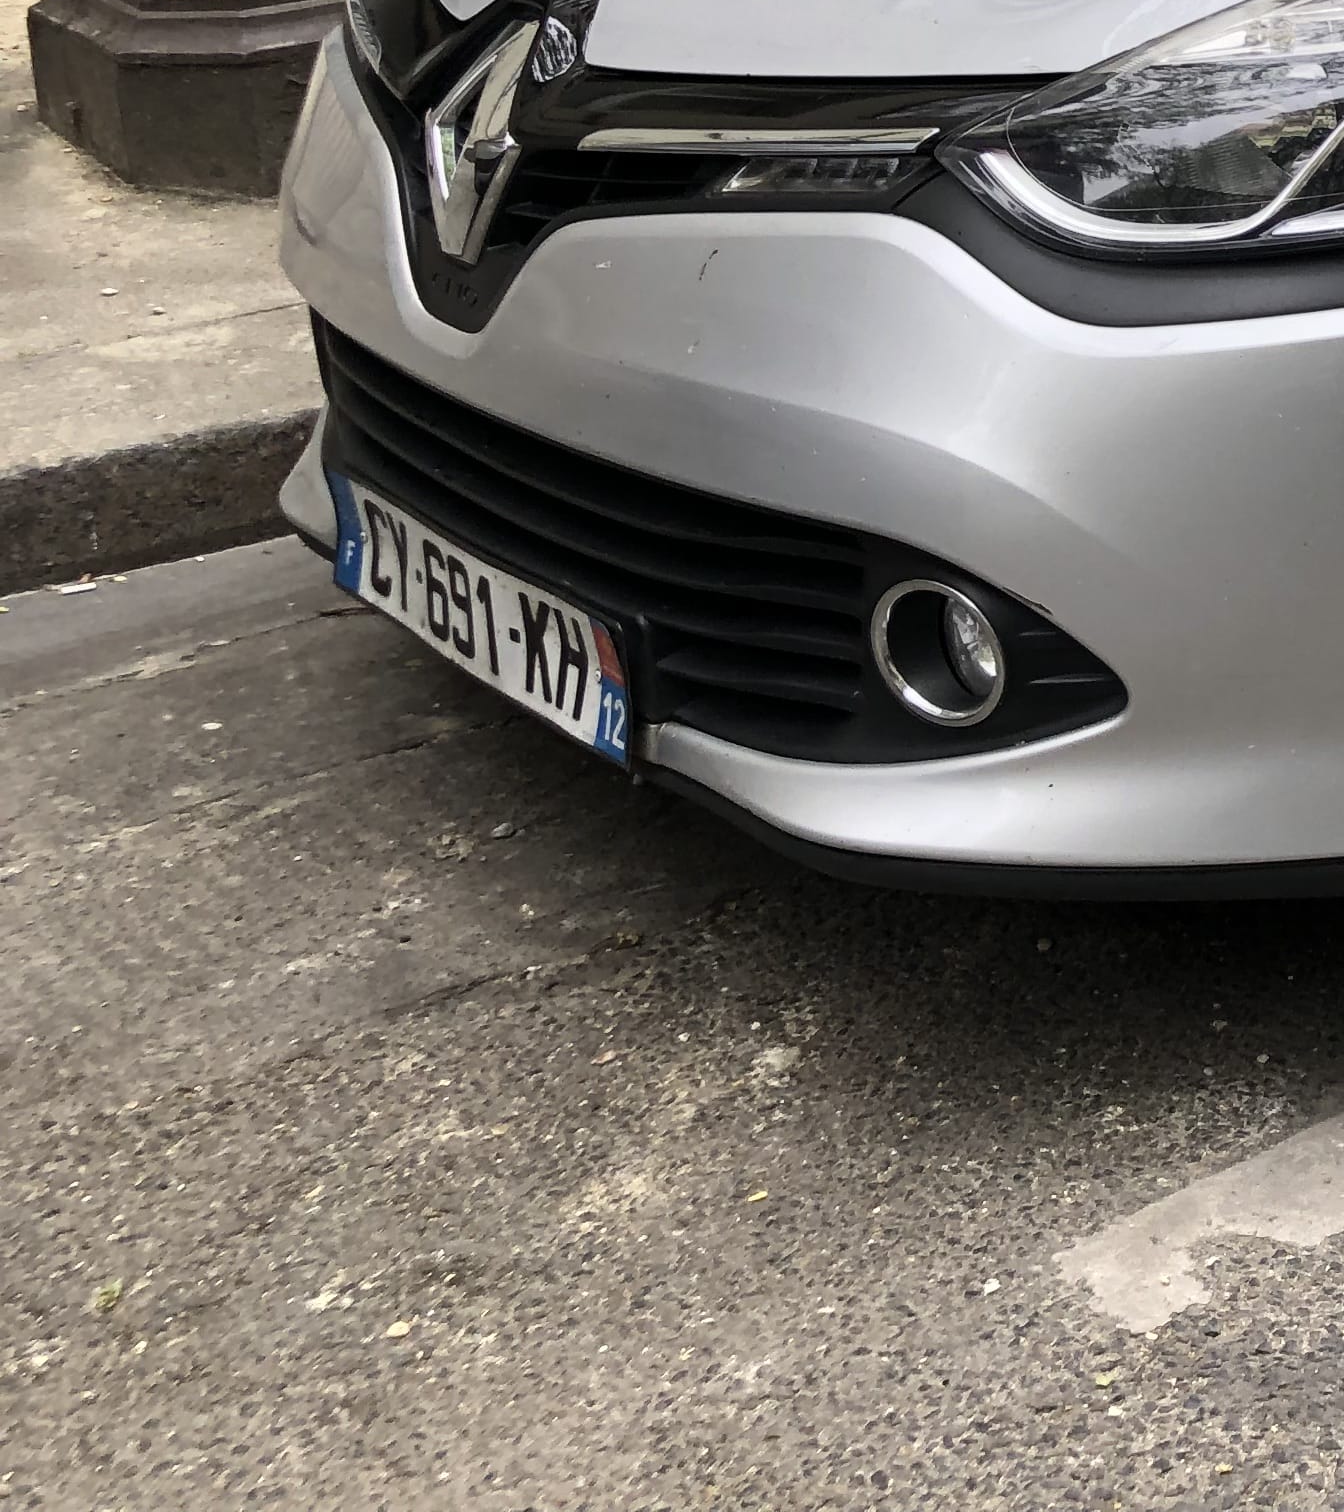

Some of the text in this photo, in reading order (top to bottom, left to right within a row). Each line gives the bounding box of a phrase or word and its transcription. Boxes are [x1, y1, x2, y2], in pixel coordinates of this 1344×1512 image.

[346, 539, 356, 565] F
[364, 498, 590, 722] CY-691-KH
[602, 691, 627, 751] 12
